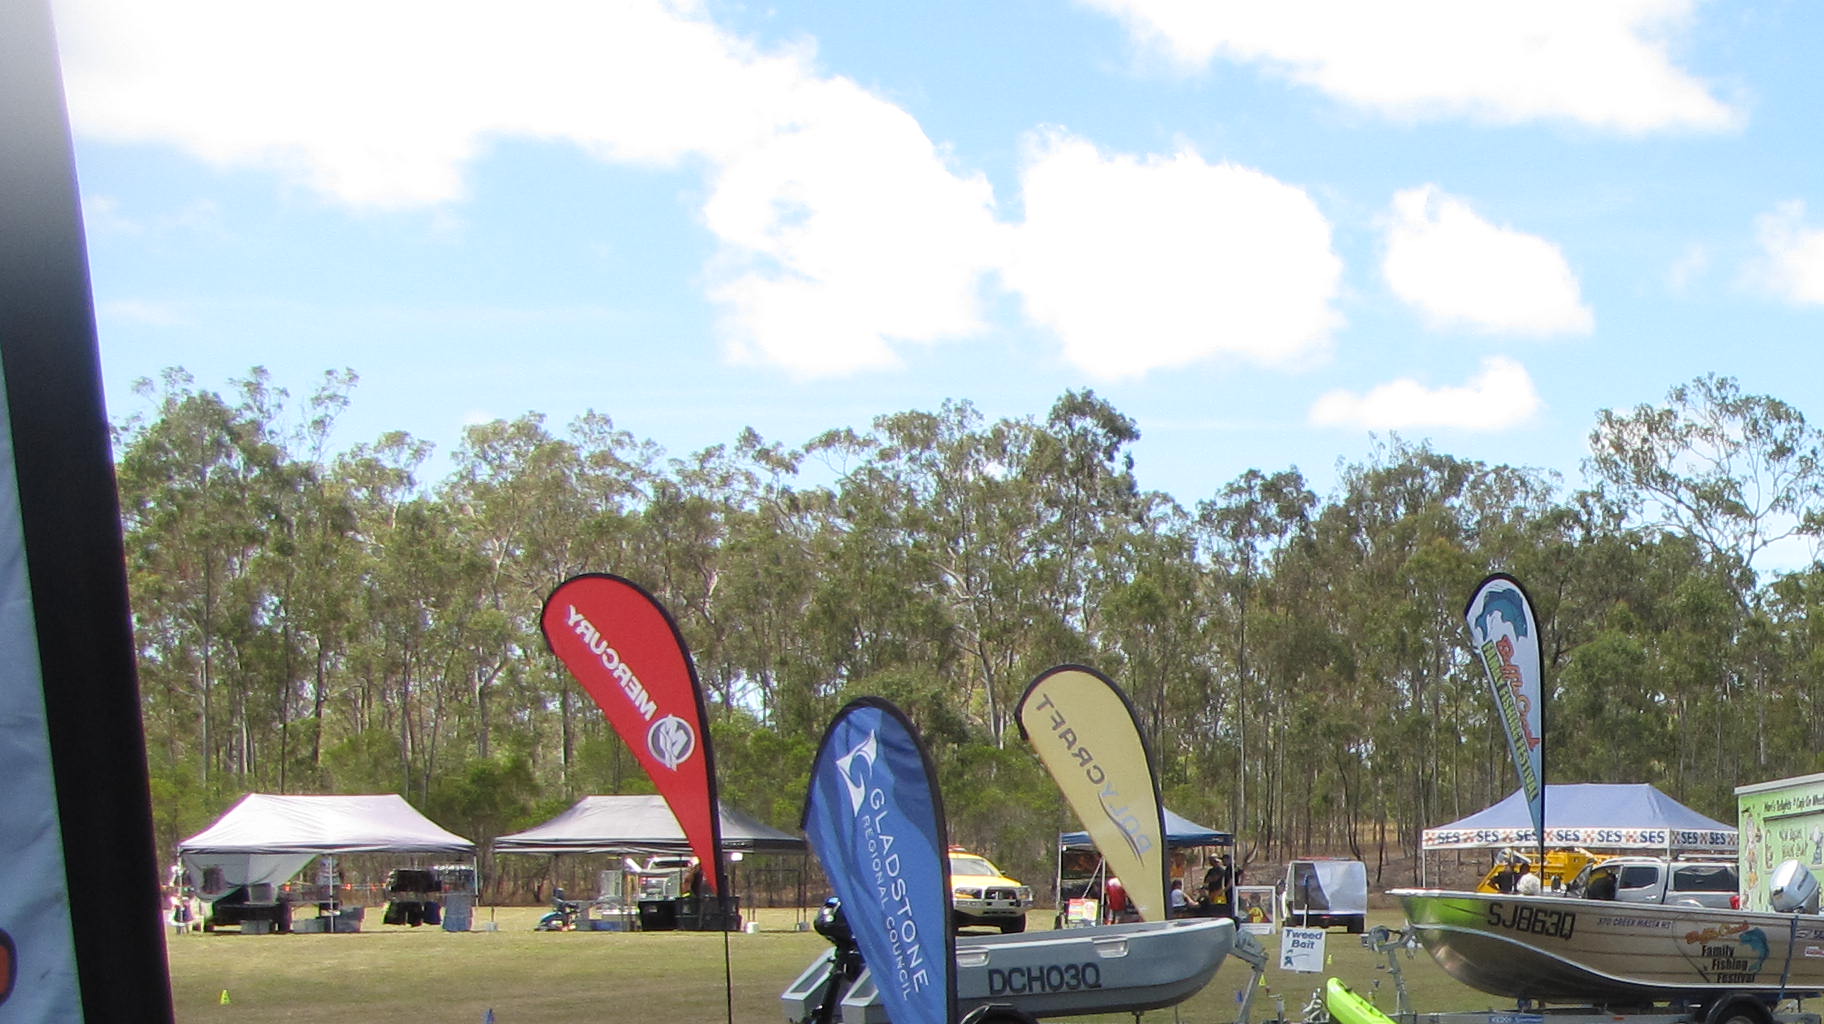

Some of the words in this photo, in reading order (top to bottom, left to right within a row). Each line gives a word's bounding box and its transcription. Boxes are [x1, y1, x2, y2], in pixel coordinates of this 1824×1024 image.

[1437, 831, 1461, 844] SES
[1476, 830, 1499, 842] SES
[1556, 830, 1580, 841] SES
[1598, 830, 1622, 843] SES
[1639, 830, 1665, 844] SES
[1680, 831, 1699, 844] SES
[1708, 832, 1727, 845] SES
[870, 788, 929, 993] GLADSTONE
[862, 815, 889, 911] REGIONAL
[886, 916, 911, 1001] COUNCIL
[1487, 902, 1576, 941] SJ863Q
[1285, 929, 1323, 940] Tweed
[1291, 940, 1315, 949] Bait
[1702, 944, 1736, 957] Family
[1711, 958, 1748, 971] Fishing
